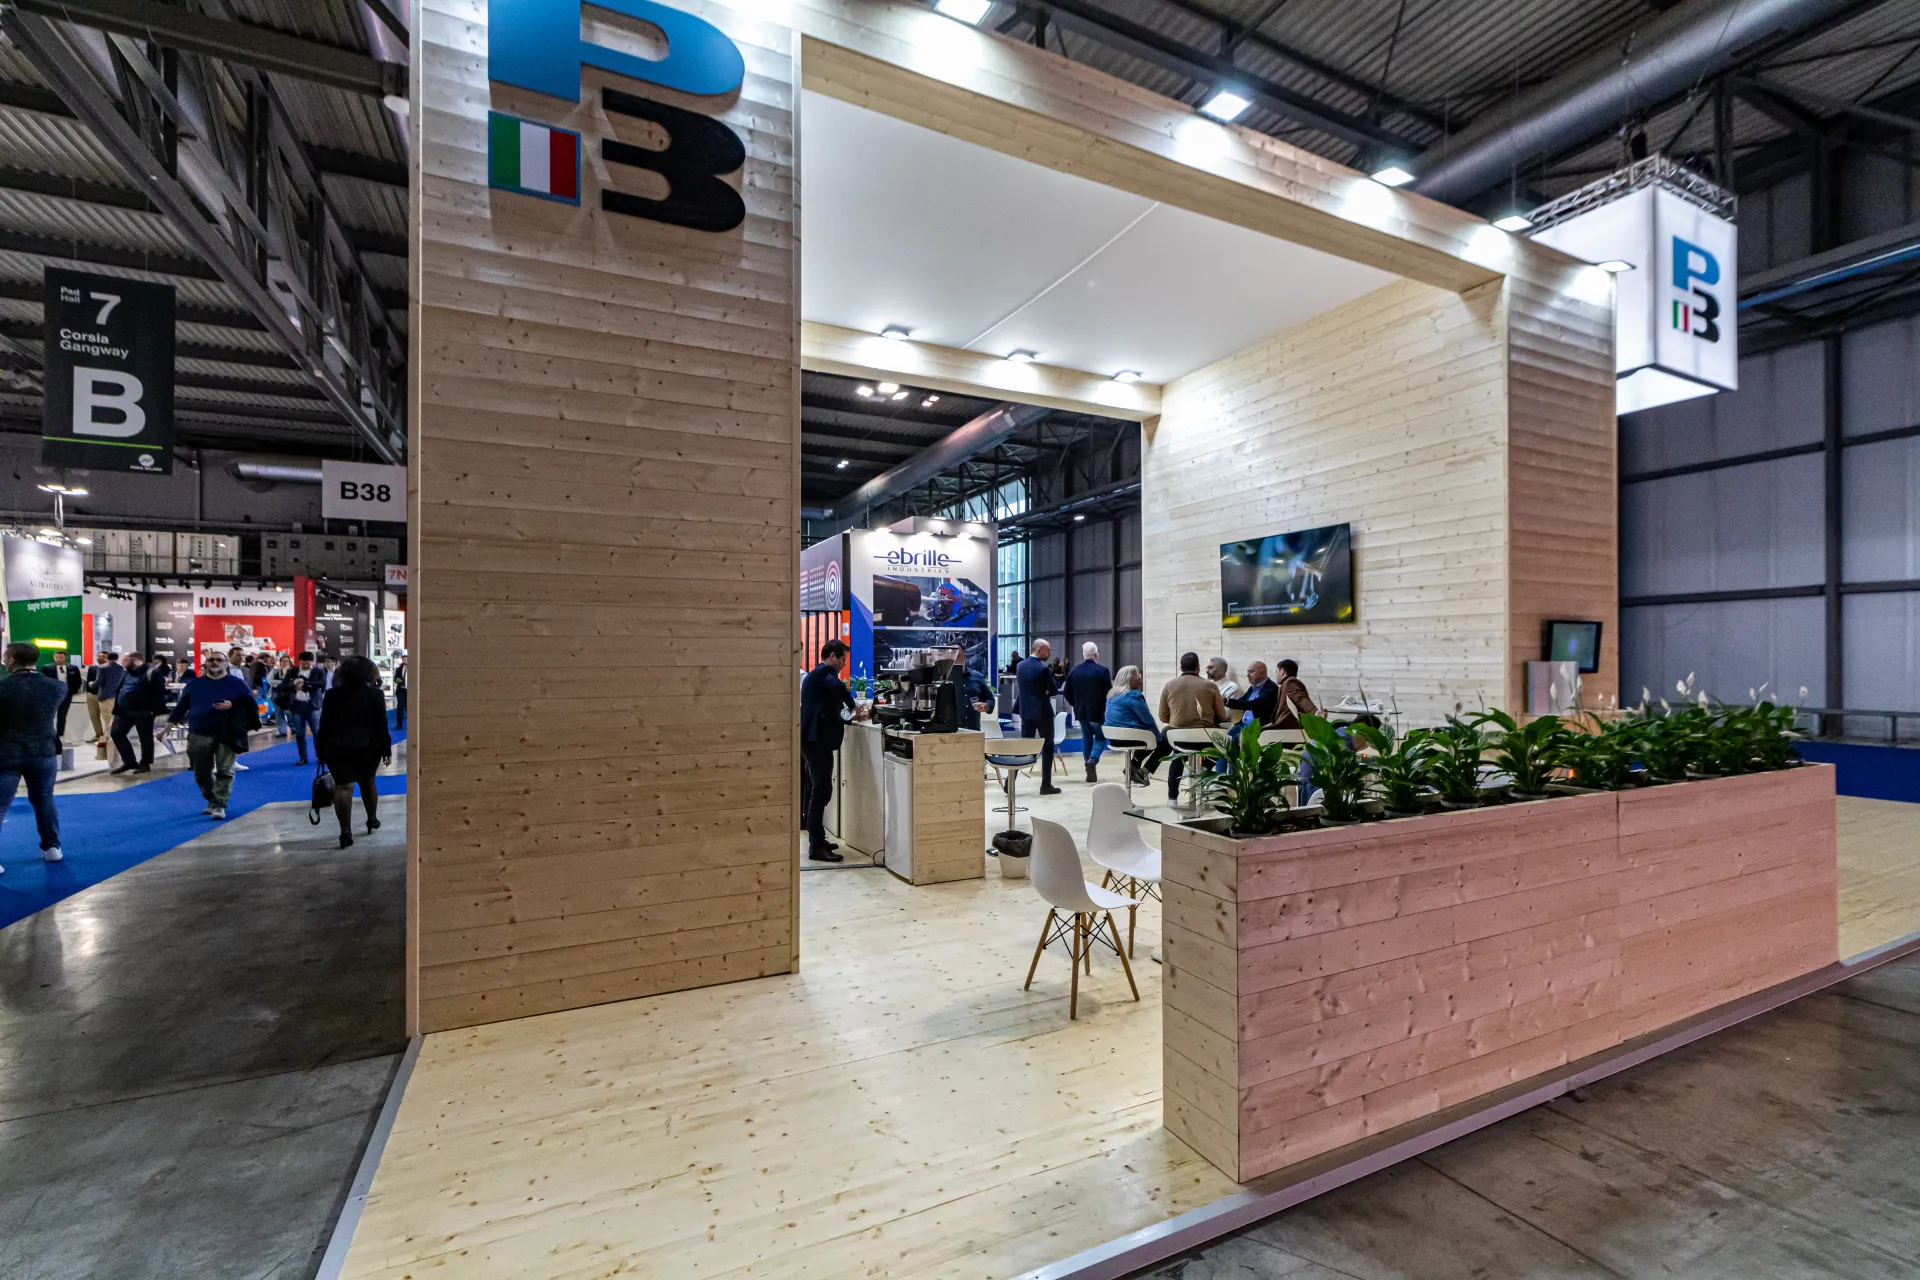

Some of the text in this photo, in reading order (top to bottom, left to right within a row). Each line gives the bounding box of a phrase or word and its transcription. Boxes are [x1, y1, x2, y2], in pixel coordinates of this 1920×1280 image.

[1672, 234, 1720, 291] P
[60, 286, 80, 296] Pad
[60, 294, 80, 304] Hall
[90, 291, 121, 325] 7
[60, 328, 109, 344] Corsia
[60, 340, 129, 359] Gangway
[73, 366, 146, 438] B
[341, 481, 391, 502] B38
[885, 548, 951, 567] ebrille
[887, 566, 950, 574] INDUSTRIES
[40, 600, 50, 609] the
[50, 600, 68, 609] energy
[232, 598, 289, 609] mikropor
